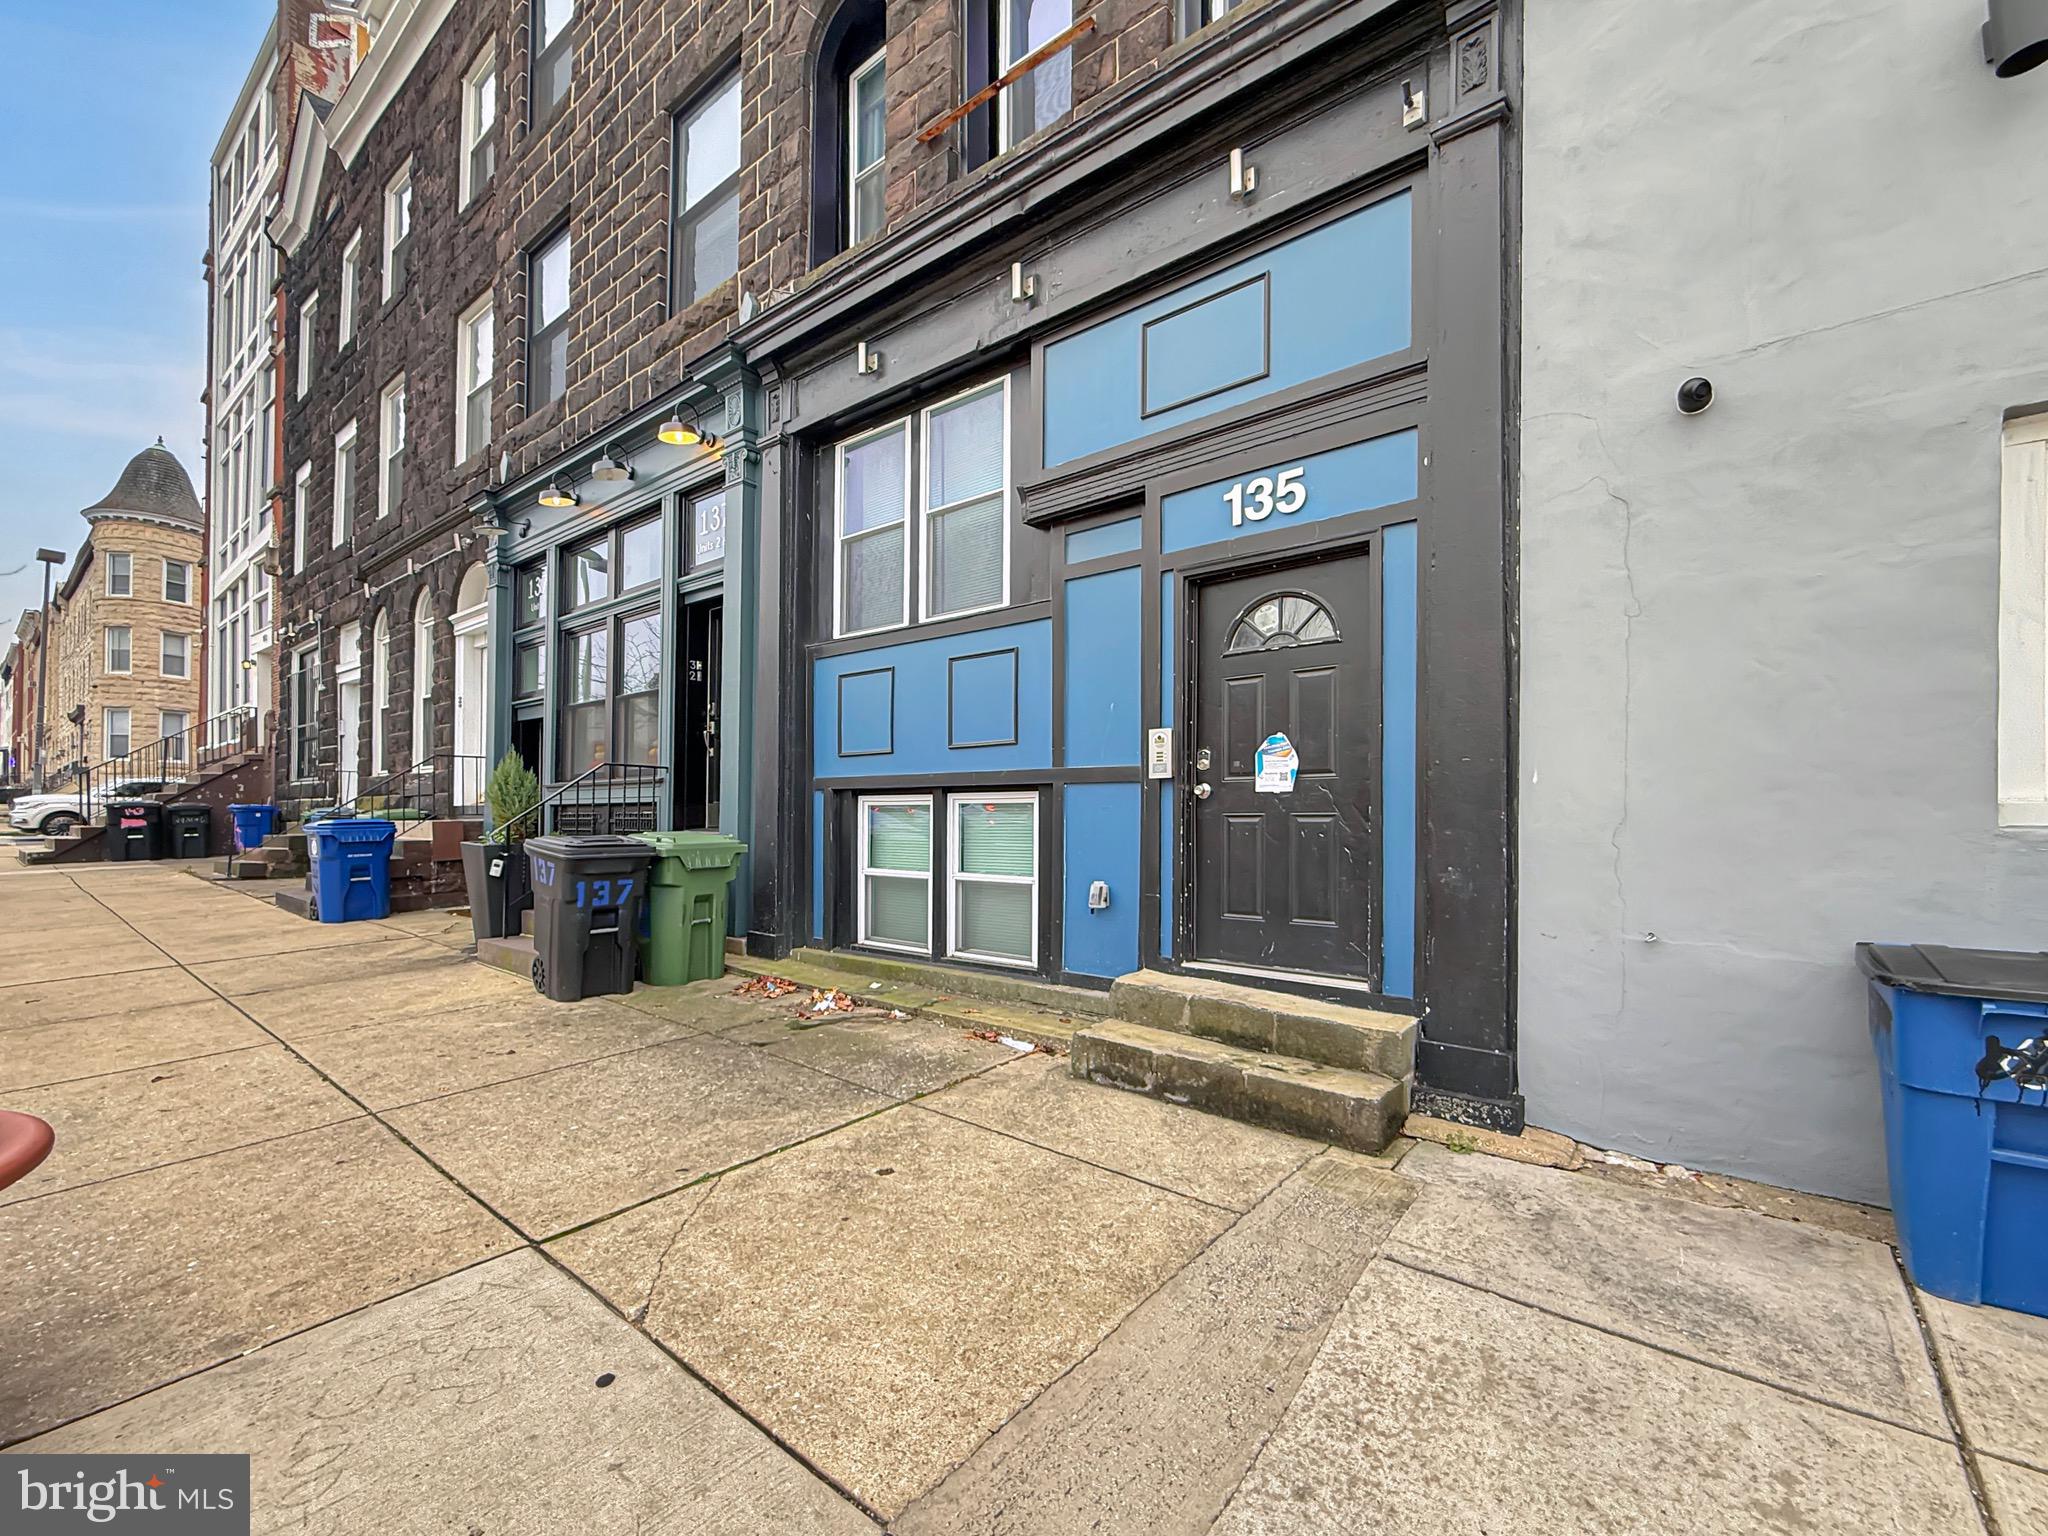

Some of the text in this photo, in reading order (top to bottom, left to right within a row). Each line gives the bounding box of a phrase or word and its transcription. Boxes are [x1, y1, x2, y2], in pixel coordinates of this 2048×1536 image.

[1223, 466, 1306, 526] 135
[697, 541, 714, 555] Units
[533, 857, 555, 887] 137
[575, 879, 634, 908] 137
